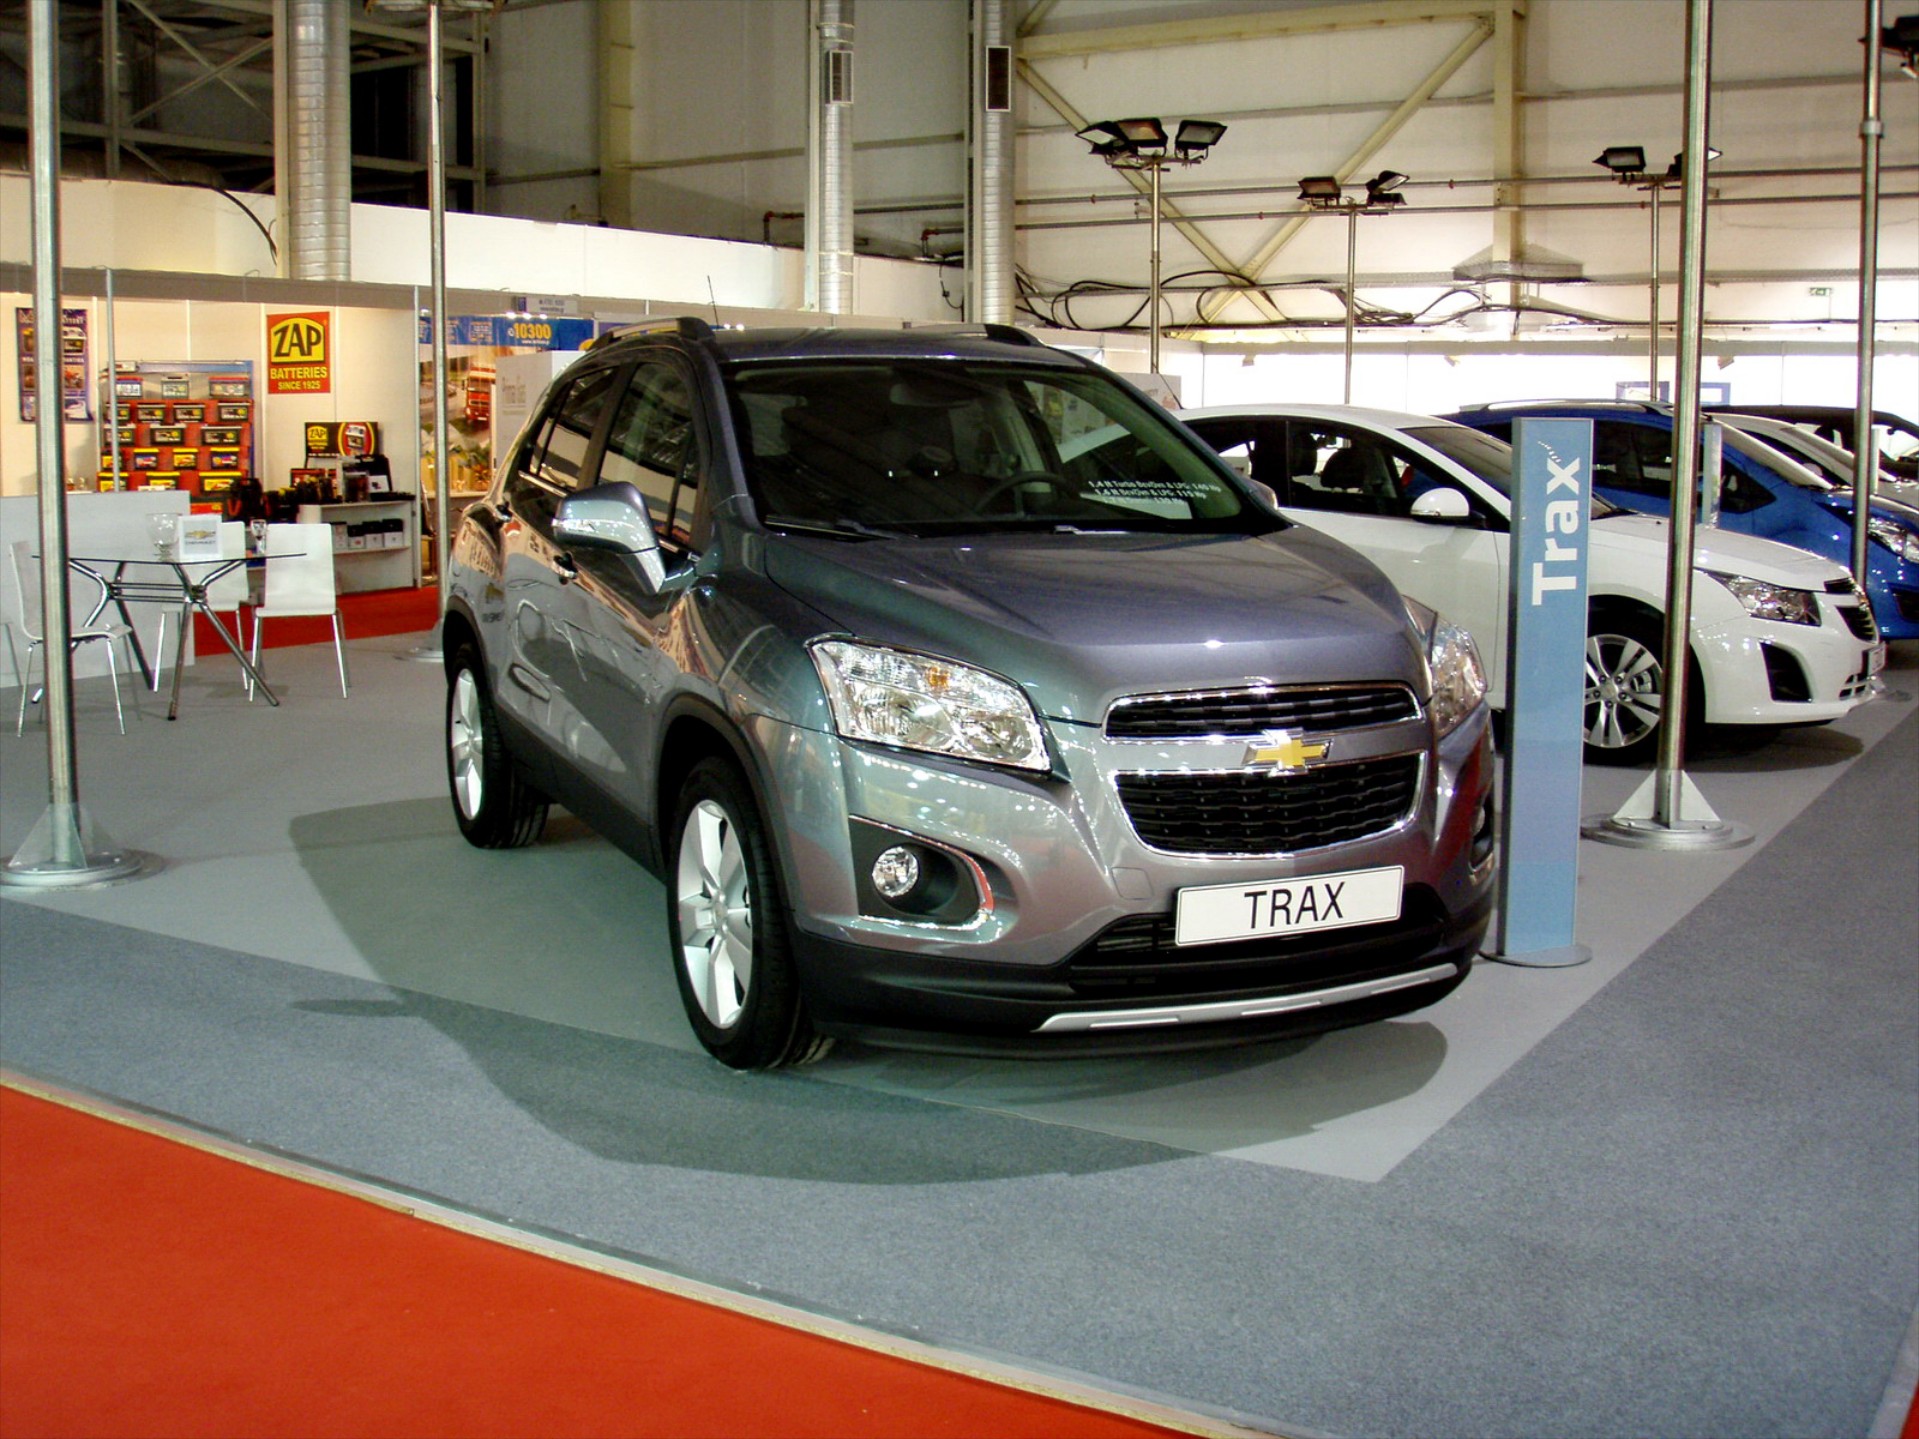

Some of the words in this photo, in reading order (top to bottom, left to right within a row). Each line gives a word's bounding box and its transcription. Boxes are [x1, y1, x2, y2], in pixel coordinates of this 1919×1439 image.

[274, 323, 322, 357] ZAP
[513, 323, 552, 339] 10300
[270, 366, 328, 380] BATTERIES
[278, 381, 301, 391] SINCE
[1532, 457, 1580, 606] Trax
[1244, 881, 1346, 929] TRAX
